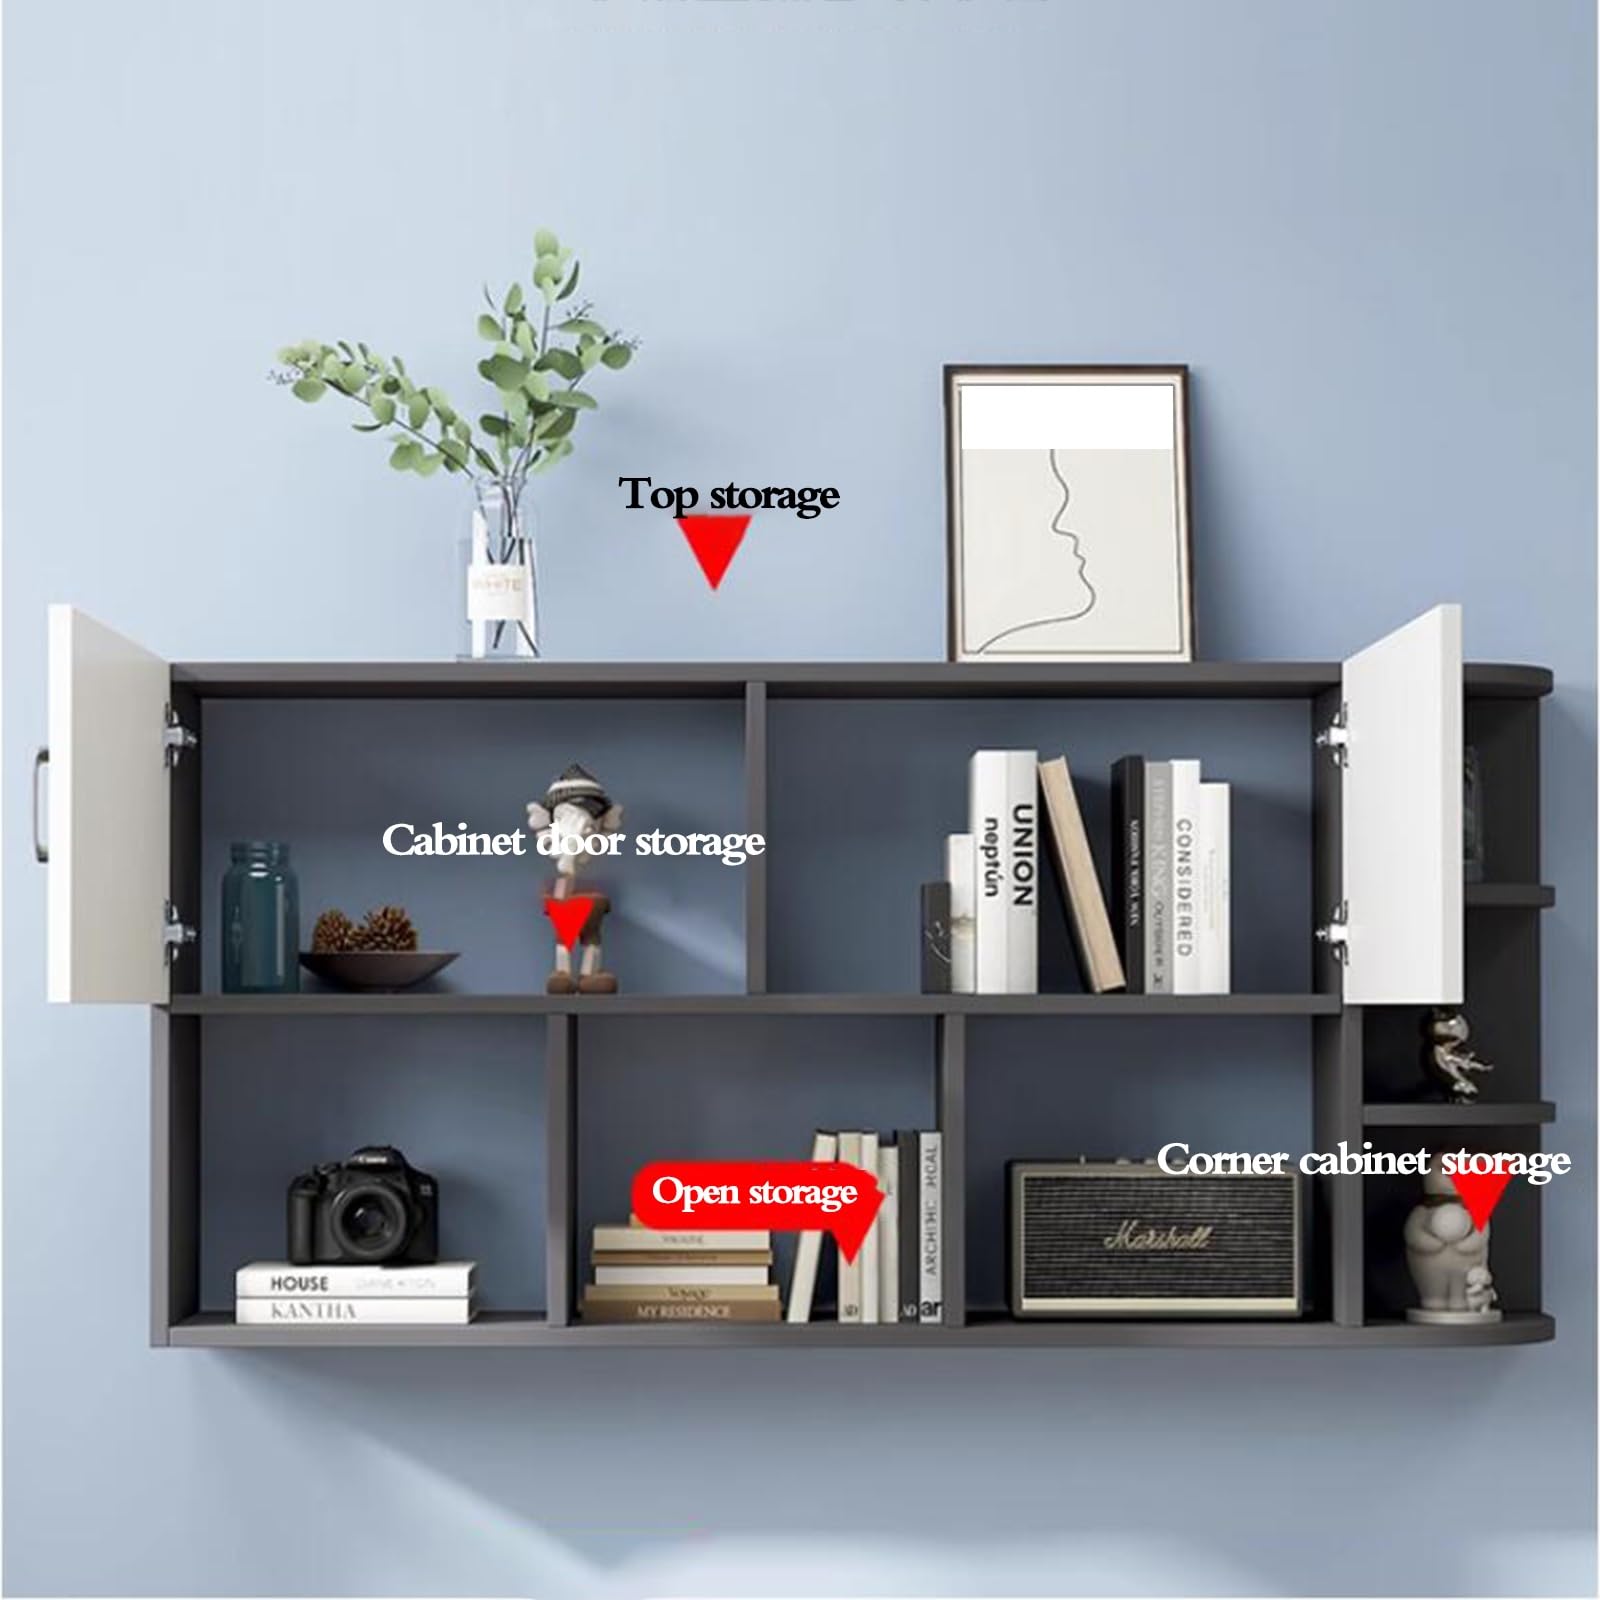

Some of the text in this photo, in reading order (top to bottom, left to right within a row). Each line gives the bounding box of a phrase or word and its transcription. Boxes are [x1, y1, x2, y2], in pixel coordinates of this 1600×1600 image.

[980, 817, 1003, 897] neptún
[1013, 804, 1033, 906] UNION
[1176, 819, 1193, 957] CONSIDERED
[1103, 1219, 1214, 1250] Marshall
[271, 1276, 329, 1293] HOUSE
[271, 1302, 357, 1320] KANTHA
[637, 1304, 731, 1319] MY RESIDENCE
